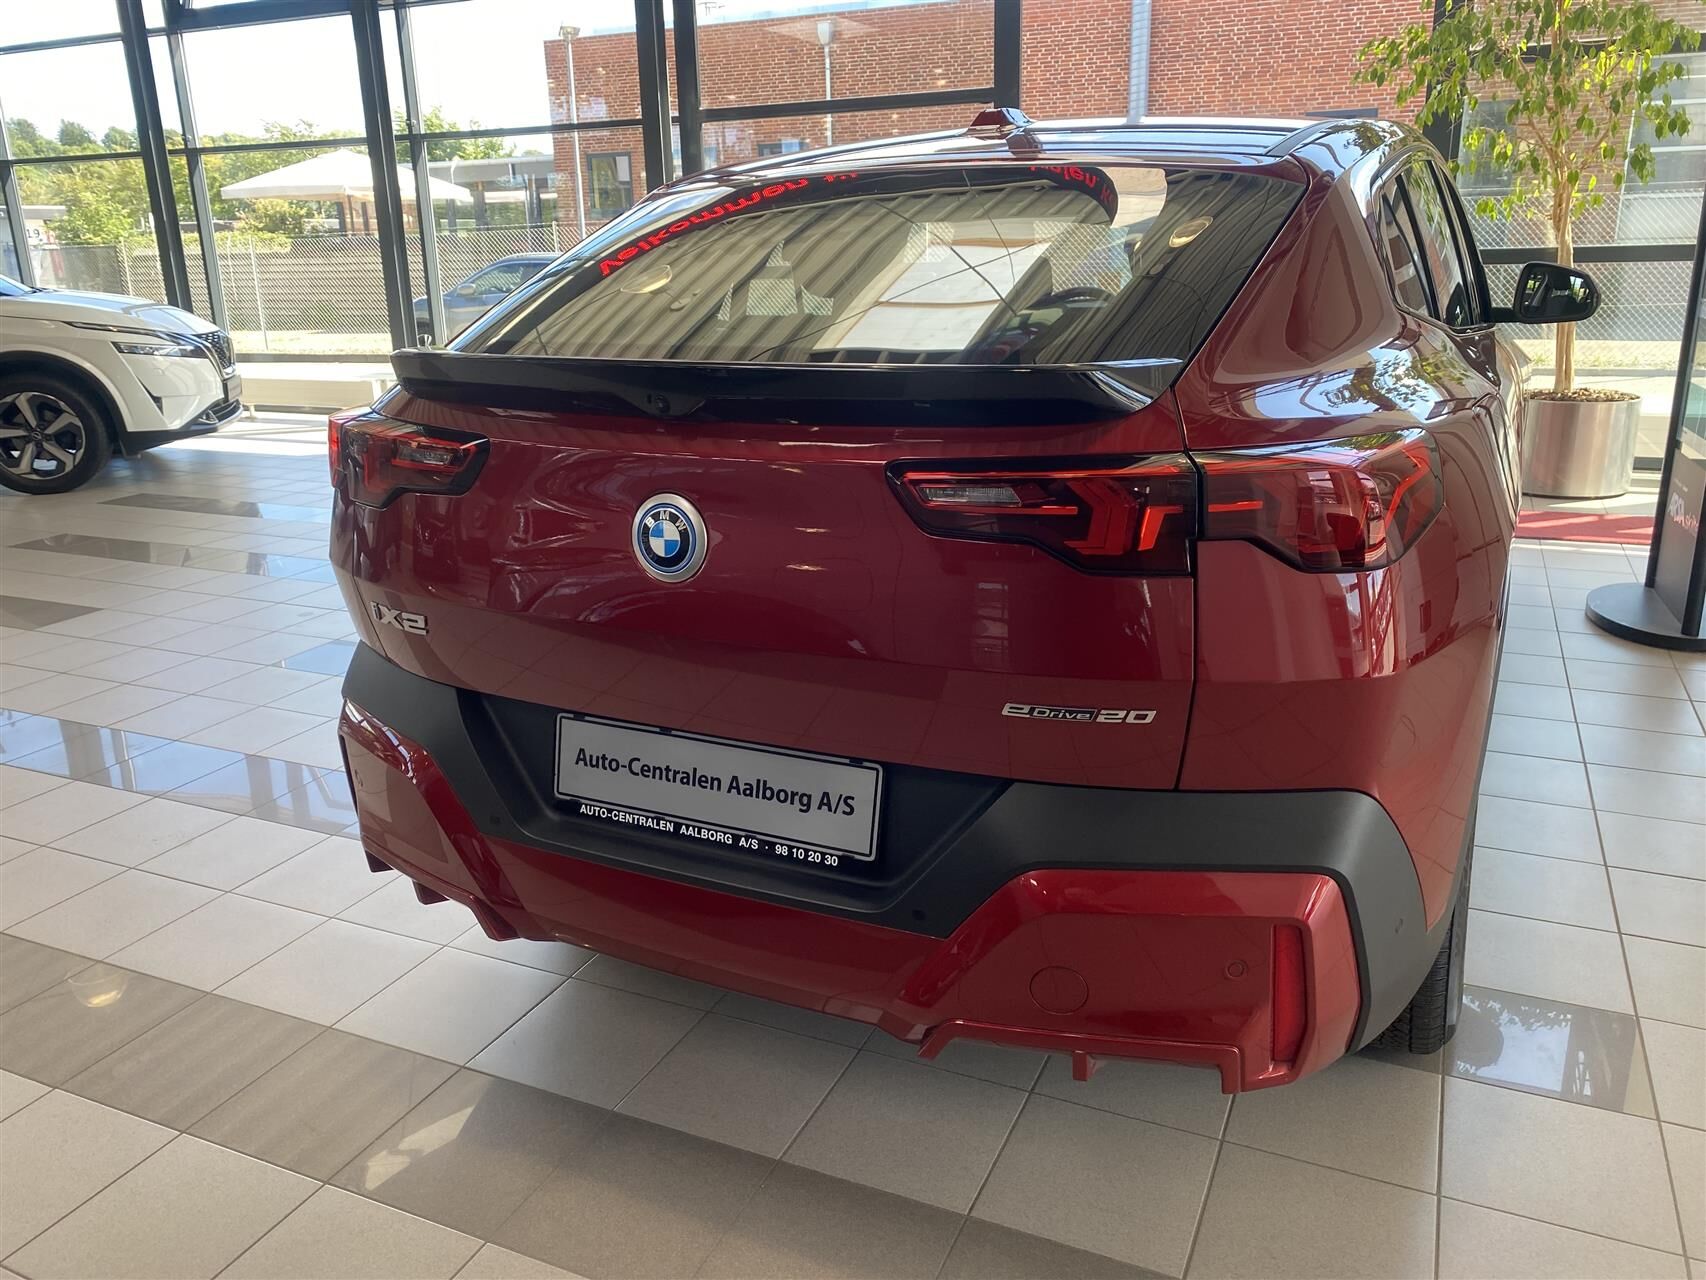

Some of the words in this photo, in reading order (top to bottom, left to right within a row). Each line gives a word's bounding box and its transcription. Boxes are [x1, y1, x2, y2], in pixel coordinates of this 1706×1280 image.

[645, 510, 687, 532] BMW
[370, 600, 427, 636] iX2
[574, 747, 722, 792] Auto-Centralen
[726, 775, 812, 814] Aalborg
[817, 791, 855, 816] A/S
[579, 803, 674, 832] AUTO-CENTRALEN
[680, 825, 733, 845] AALBORG
[739, 836, 759, 850] A/S
[774, 844, 788, 857] 98
[791, 848, 805, 860] 10
[807, 851, 821, 863] 20
[824, 854, 838, 867] 30
